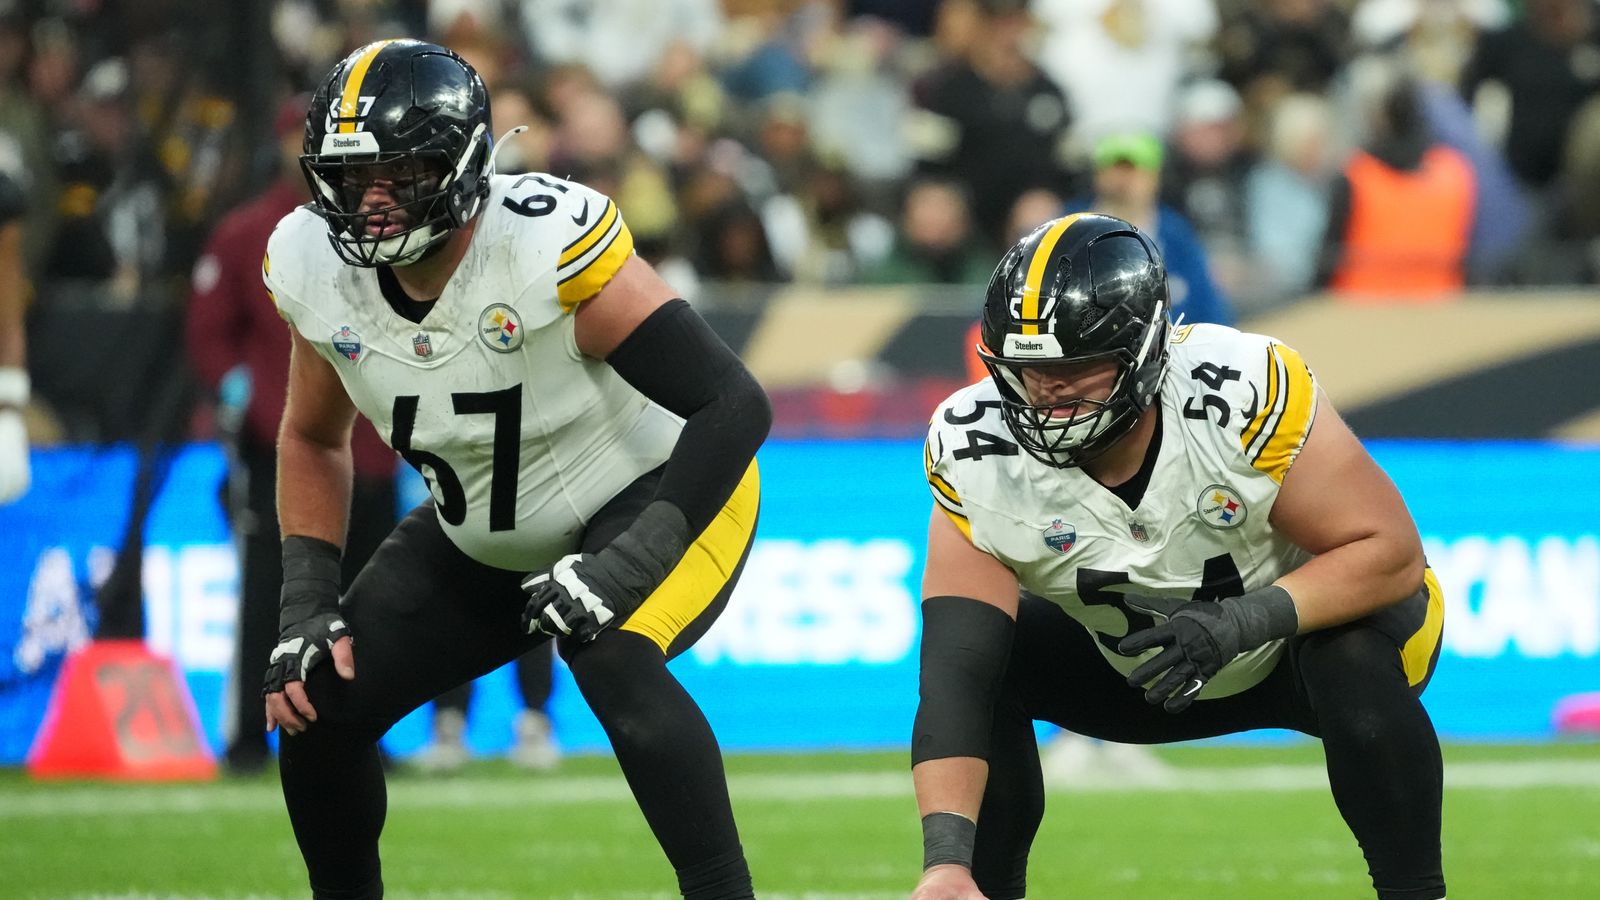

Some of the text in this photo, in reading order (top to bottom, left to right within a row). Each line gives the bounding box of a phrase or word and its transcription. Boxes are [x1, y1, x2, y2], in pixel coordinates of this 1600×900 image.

[325, 96, 377, 134] 67
[333, 138, 360, 148] Steelers
[502, 175, 569, 218] 67
[1014, 340, 1043, 350] Steelers
[1183, 362, 1242, 429] 54
[943, 400, 1019, 461] 54
[390, 382, 522, 532] 67
[1050, 534, 1071, 542] PARIS
